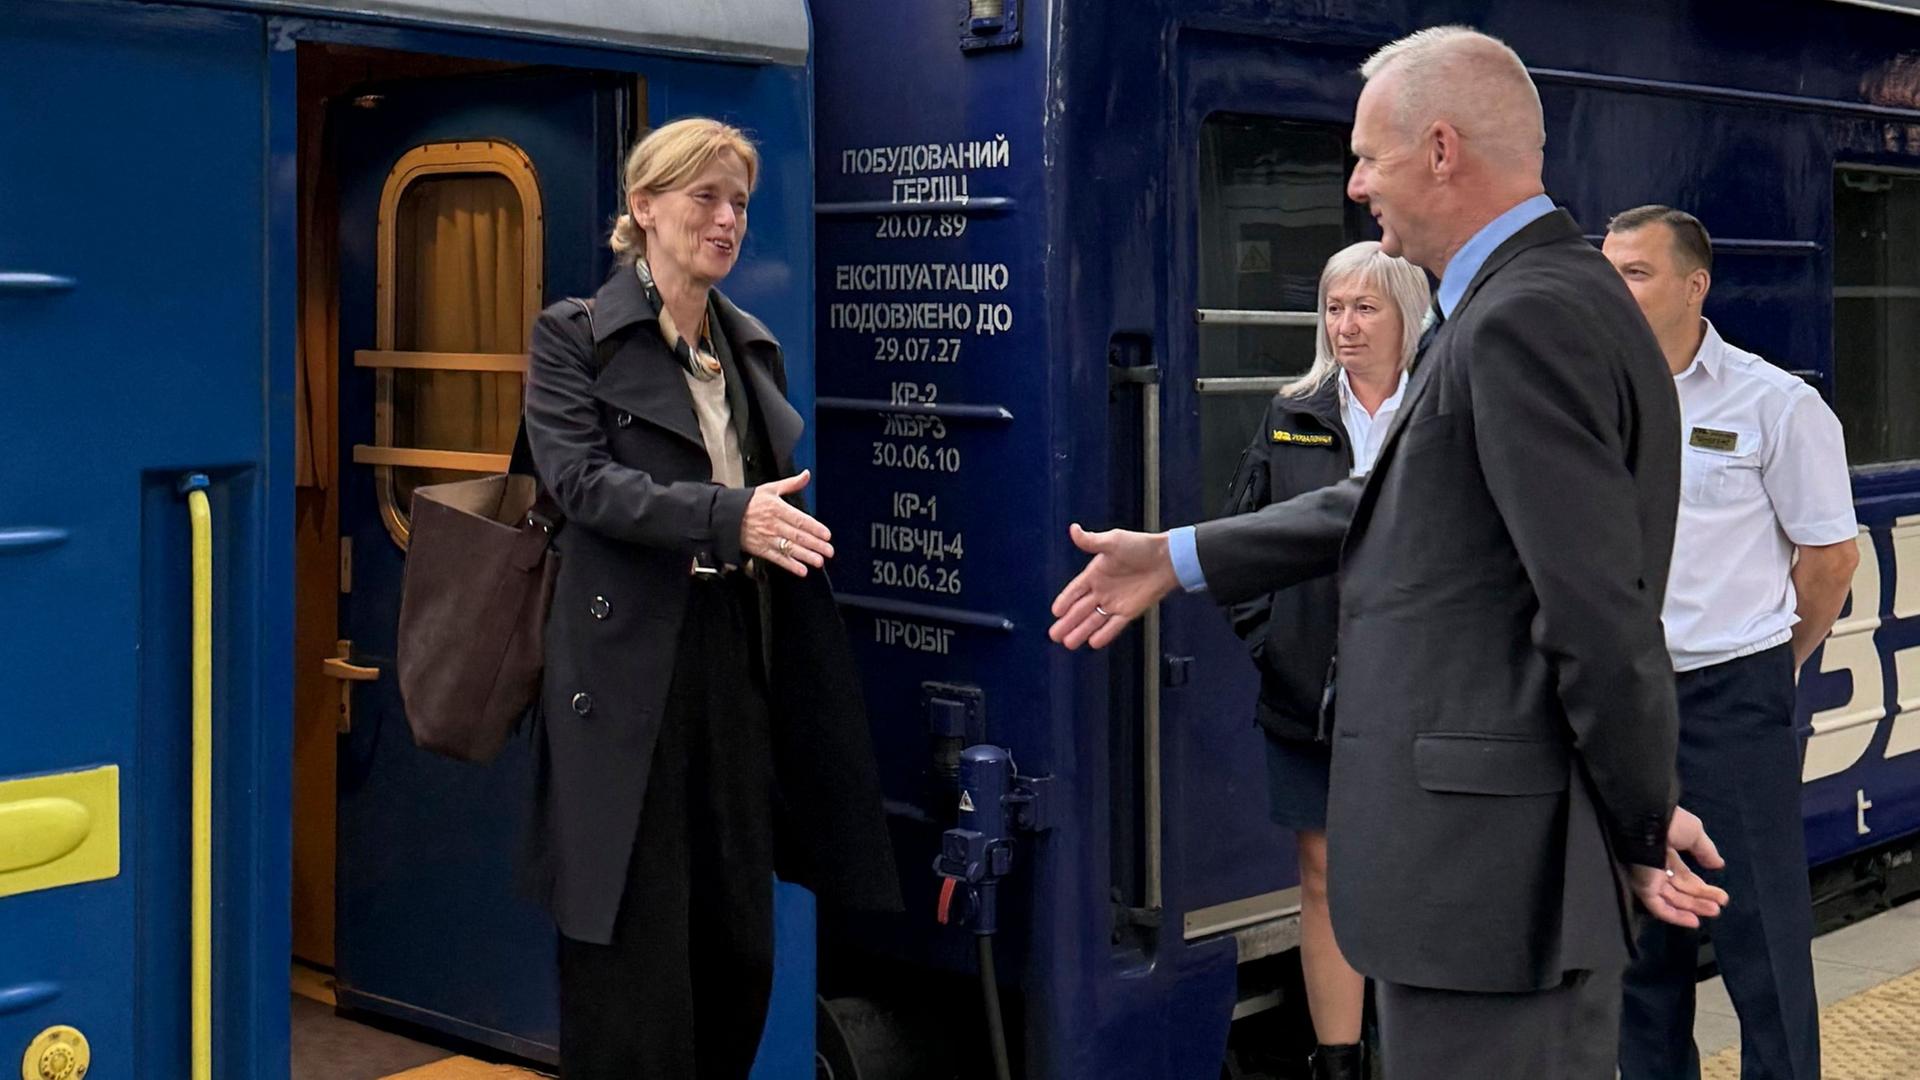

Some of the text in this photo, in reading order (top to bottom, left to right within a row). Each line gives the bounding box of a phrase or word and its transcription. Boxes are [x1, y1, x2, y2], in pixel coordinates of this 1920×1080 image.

[842, 134, 1010, 175] ПОБУДОВАНИЙ
[892, 175, 969, 205] ГЕРЛІЦ
[876, 215, 967, 238] 20.07.89
[836, 264, 1009, 293] ЕКСПЛУАТАЦІЮ
[831, 303, 1012, 335] ПОДОВЖЕНО ДО
[875, 337, 961, 362] 29.07.27
[890, 382, 937, 408] КР-2
[872, 442, 960, 472] 30.06.10
[893, 491, 937, 521] КР-1
[871, 522, 963, 562] ПКВЧД-4
[872, 559, 961, 594] 30.06.26
[875, 618, 955, 654] ПРОБІГ
